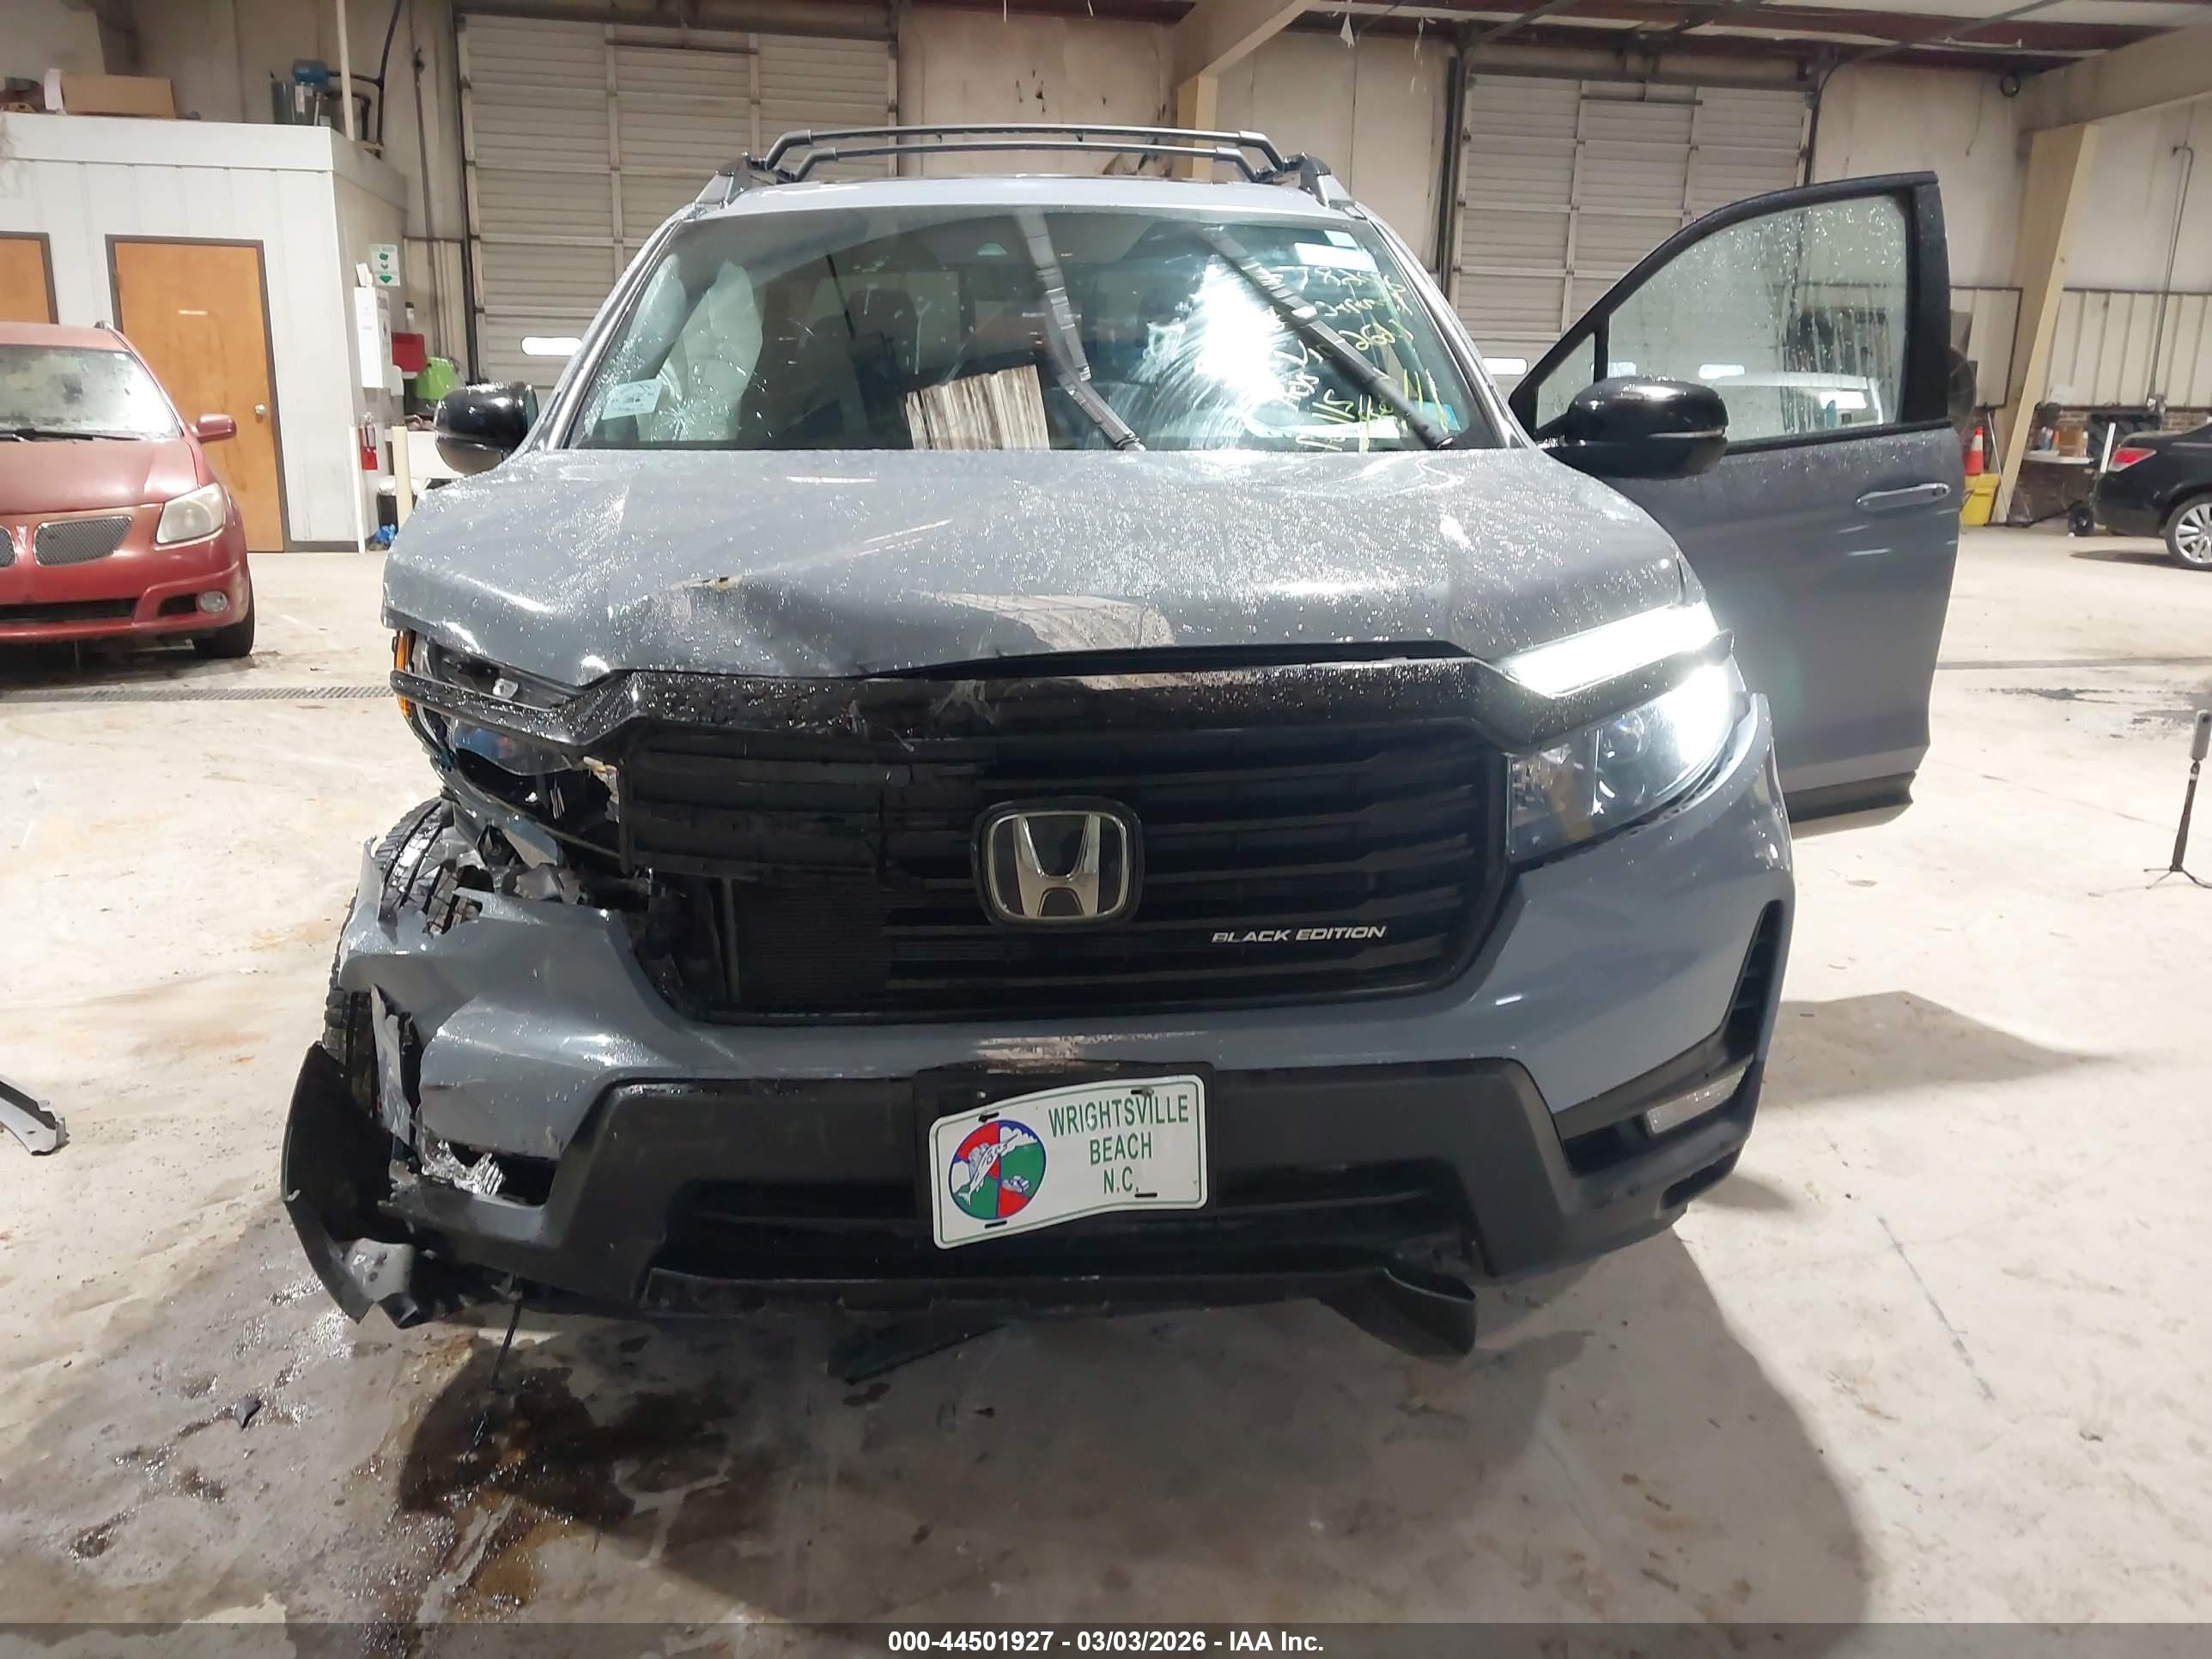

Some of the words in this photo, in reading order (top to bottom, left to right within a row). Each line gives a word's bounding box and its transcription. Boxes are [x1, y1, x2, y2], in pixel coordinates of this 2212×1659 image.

[1211, 929, 1291, 943] BLACK
[1295, 926, 1388, 941] EDITION
[1048, 1094, 1190, 1138] WRIGHTSVILLE
[1090, 1131, 1153, 1166] BEACH
[1103, 1166, 1140, 1195] N.C.
